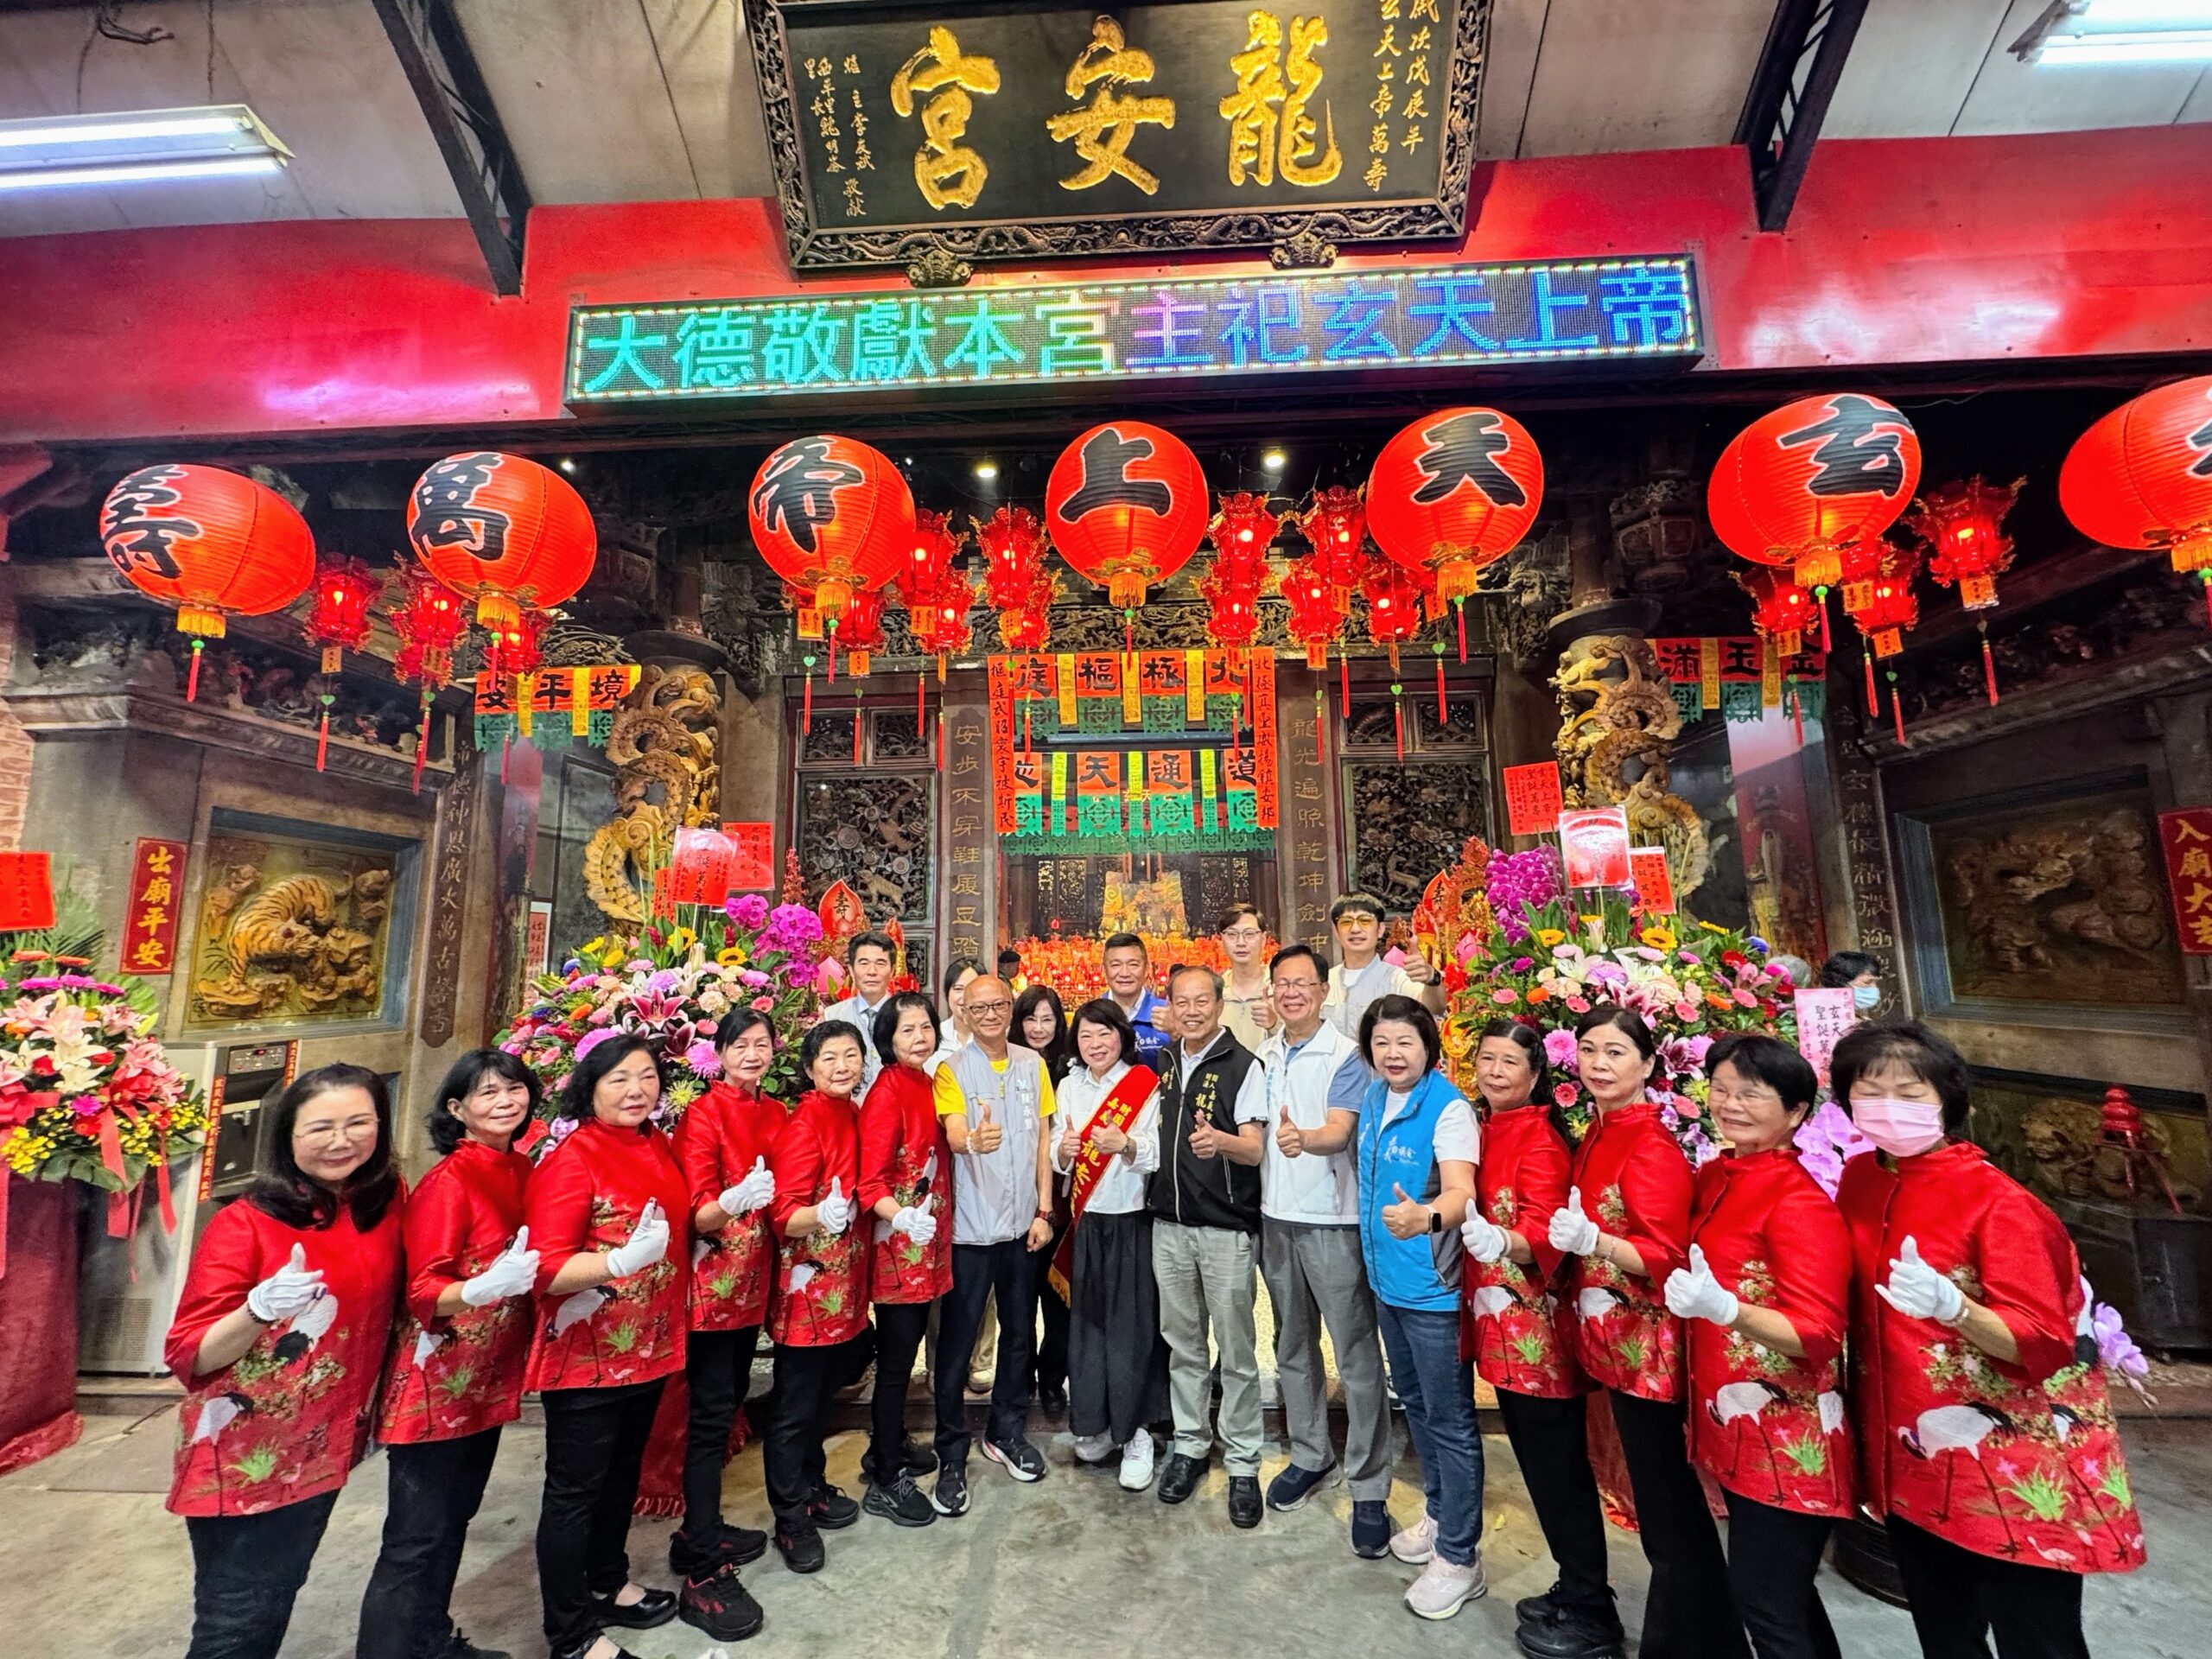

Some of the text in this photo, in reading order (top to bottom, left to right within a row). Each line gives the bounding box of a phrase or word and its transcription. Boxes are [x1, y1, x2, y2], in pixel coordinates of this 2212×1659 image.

[889, 9, 1343, 212] 龍安宮
[582, 269, 1688, 395] 大德敬獻本宮主祀玄天上帝
[752, 435, 865, 555] 帝
[1058, 428, 1173, 523] 上
[1410, 411, 1528, 508] 天
[1776, 393, 1916, 499] 玄
[131, 845, 175, 968] 出廟平安
